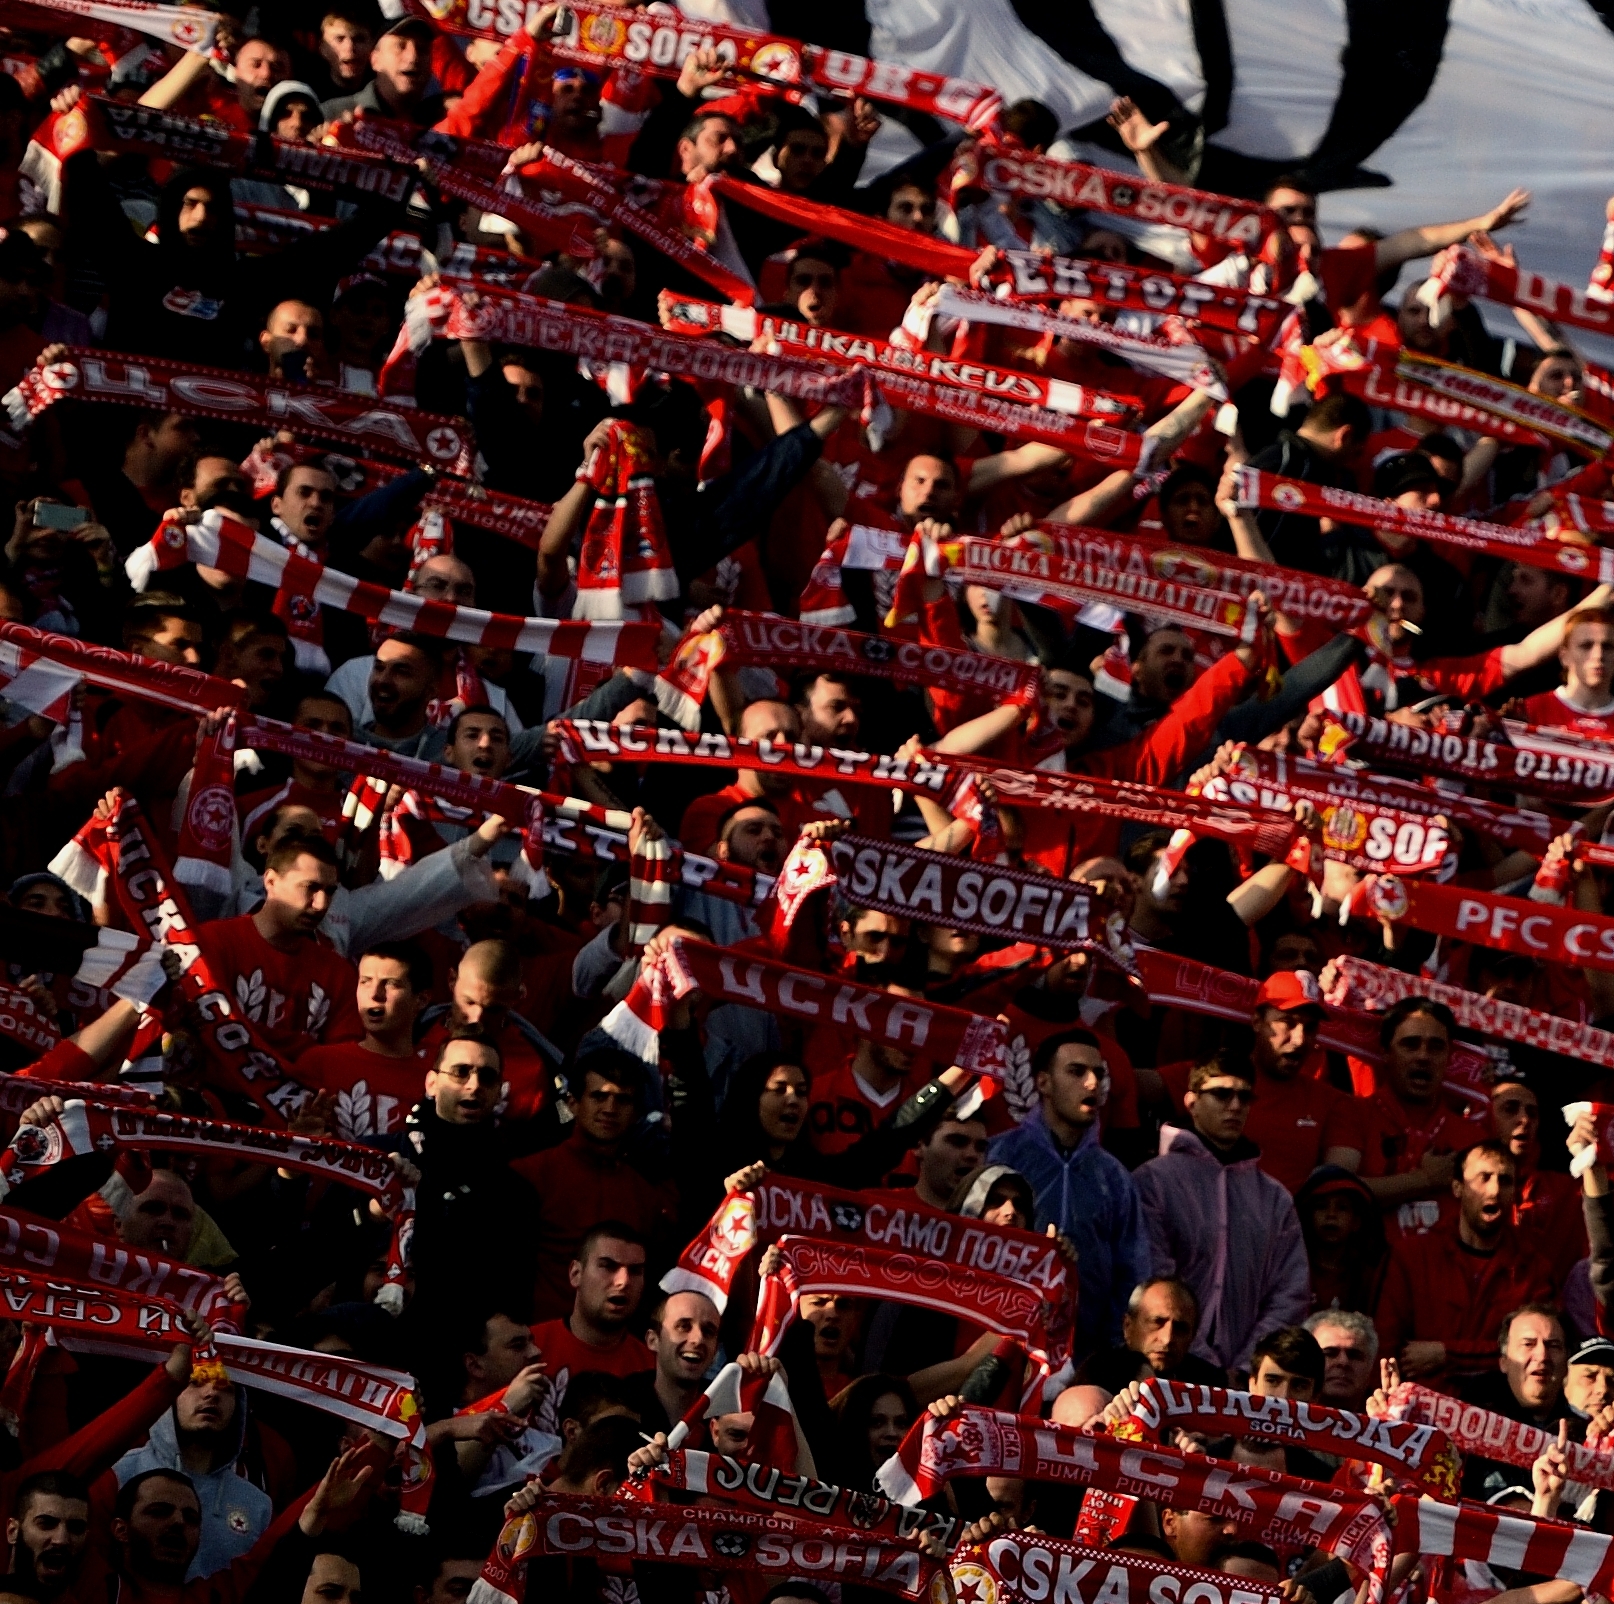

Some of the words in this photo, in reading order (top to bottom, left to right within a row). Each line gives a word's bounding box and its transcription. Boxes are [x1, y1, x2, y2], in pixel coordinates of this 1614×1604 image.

[982, 155, 1102, 203] CSKA
[1140, 190, 1261, 246] SOFIA
[80, 358, 424, 453] ЦСКА
[741, 623, 857, 662] ЦСКА
[899, 642, 1020, 693] СОФИЯ
[1366, 816, 1453, 864] SOF
[830, 840, 943, 914] CSKA
[953, 879, 1091, 938] SOFIA
[1455, 898, 1553, 952] PFC
[116, 828, 317, 1120] ЦСКА-СОФИ
[717, 955, 939, 1048] ЦСКА
[865, 1202, 950, 1260] САМО
[788, 1240, 873, 1281] СКА
[879, 1252, 1044, 1326] СОФИЯ
[1249, 1419, 1305, 1441] SOFIA
[681, 1506, 798, 1532] CHAMPION
[1034, 1426, 1343, 1532] ЦСКА
[1035, 1460, 1094, 1483] PUMA
[1115, 1476, 1176, 1503] PUMA
[1198, 1499, 1255, 1526] PUMA
[1267, 1517, 1323, 1547] PUMA
[543, 1510, 710, 1561] CSKA
[754, 1531, 924, 1595] SOFIA
